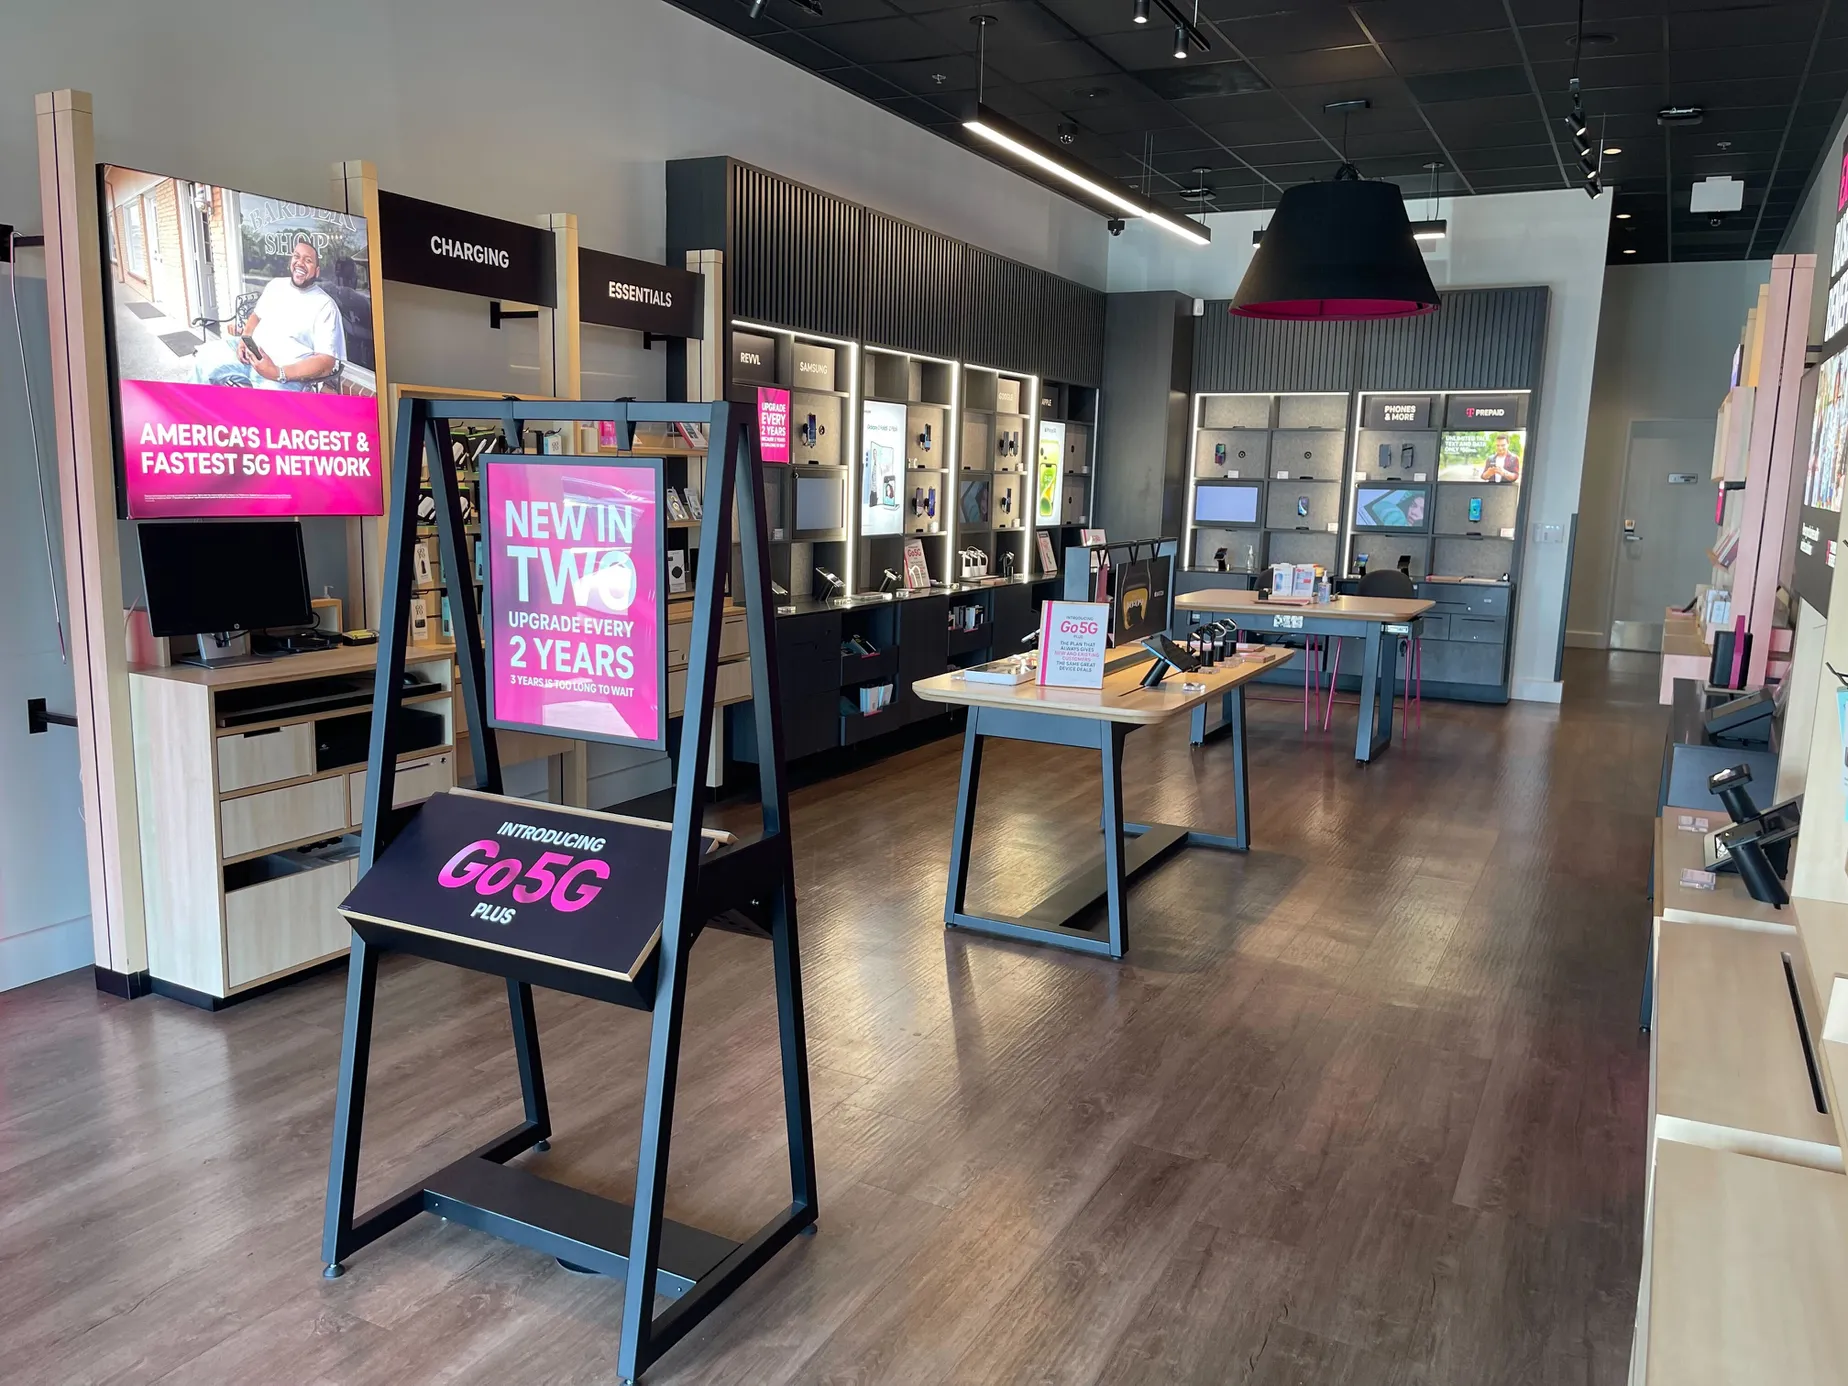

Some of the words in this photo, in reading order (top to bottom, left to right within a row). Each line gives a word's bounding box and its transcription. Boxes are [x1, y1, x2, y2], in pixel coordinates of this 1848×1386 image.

[265, 232, 329, 258] SHOP
[430, 235, 509, 269] CHARGING
[608, 281, 672, 308] ESSENTIALS
[740, 352, 761, 365] REVVL
[800, 362, 828, 374] SAMSUNG
[761, 402, 786, 412] UPGRADE
[761, 412, 786, 425] EVERY
[1384, 405, 1416, 413] PHONES
[1475, 408, 1505, 417] PREPAID
[140, 422, 260, 448] AMERICA'S
[266, 428, 352, 451] LARGEST
[356, 432, 370, 452] &
[761, 425, 766, 435] 2
[767, 426, 786, 436] YEARS
[141, 452, 237, 475] FASTEST
[242, 453, 271, 476] 5G
[276, 455, 371, 477] NETWORK
[505, 500, 587, 541] NEW
[597, 504, 633, 543] IN
[506, 545, 637, 611] TWO
[508, 611, 580, 634] UPGRADE
[584, 616, 634, 637] EVERY
[1060, 620, 1098, 635] Go5G
[510, 635, 527, 668] 2
[533, 638, 634, 679] YEARS
[510, 675, 516, 684] 3
[517, 675, 543, 687] YEARS
[545, 679, 553, 687] IS
[554, 679, 572, 690] TOO
[573, 682, 597, 693] LONG
[598, 684, 610, 695] TO
[611, 687, 634, 697] WAIT
[497, 821, 607, 853] INTRODUCING
[437, 839, 611, 913] Go5G
[470, 902, 517, 925] PLUS
